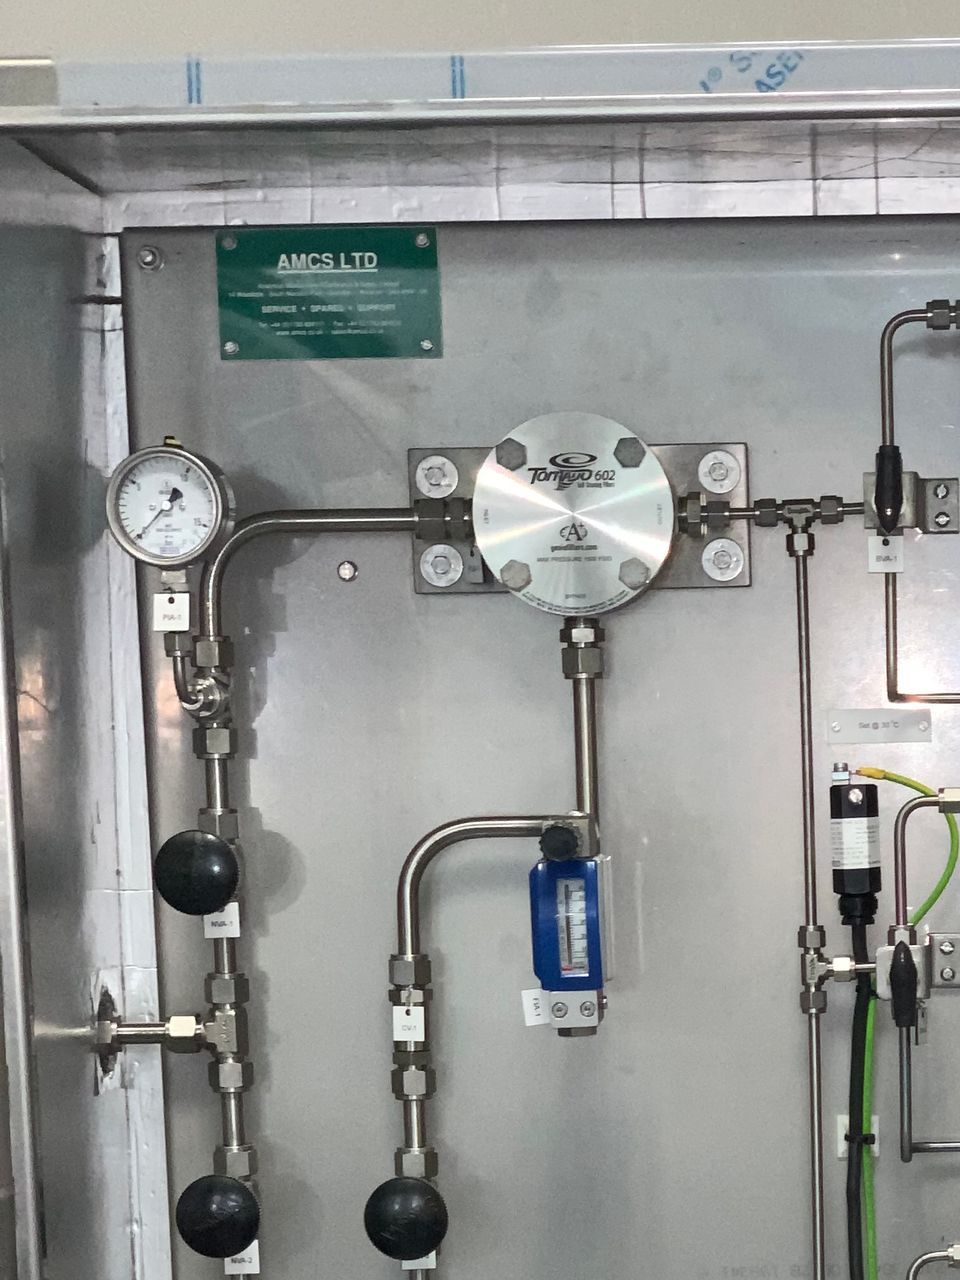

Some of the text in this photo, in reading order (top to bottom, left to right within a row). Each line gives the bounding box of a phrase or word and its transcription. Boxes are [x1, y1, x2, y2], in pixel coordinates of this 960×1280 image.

[277, 252, 378, 270] AMCS LTD
[594, 469, 616, 481] 602
